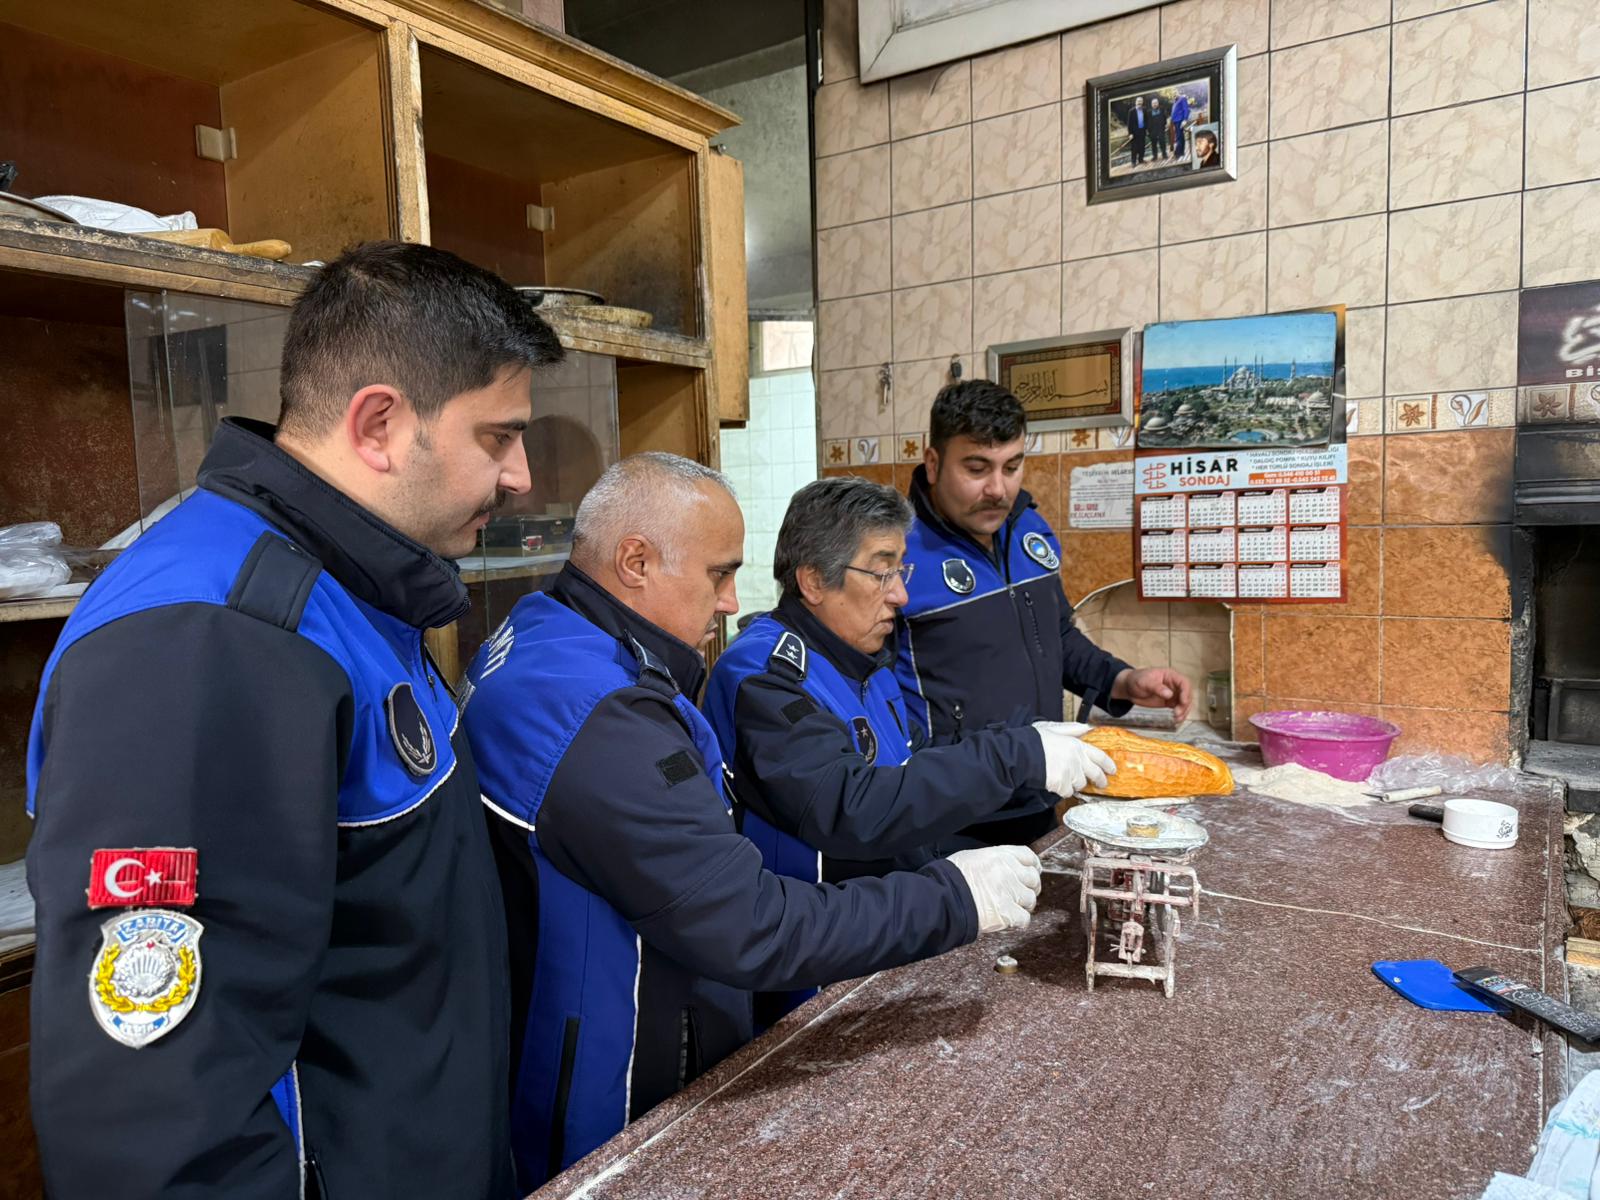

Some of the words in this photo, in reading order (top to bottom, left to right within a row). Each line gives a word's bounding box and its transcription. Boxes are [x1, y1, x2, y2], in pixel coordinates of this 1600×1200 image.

[1565, 365, 1600, 378] Bİ
[1170, 457, 1238, 475] HİSAR
[1179, 474, 1230, 487] SONDAJ
[122, 916, 179, 934] ZABITA
